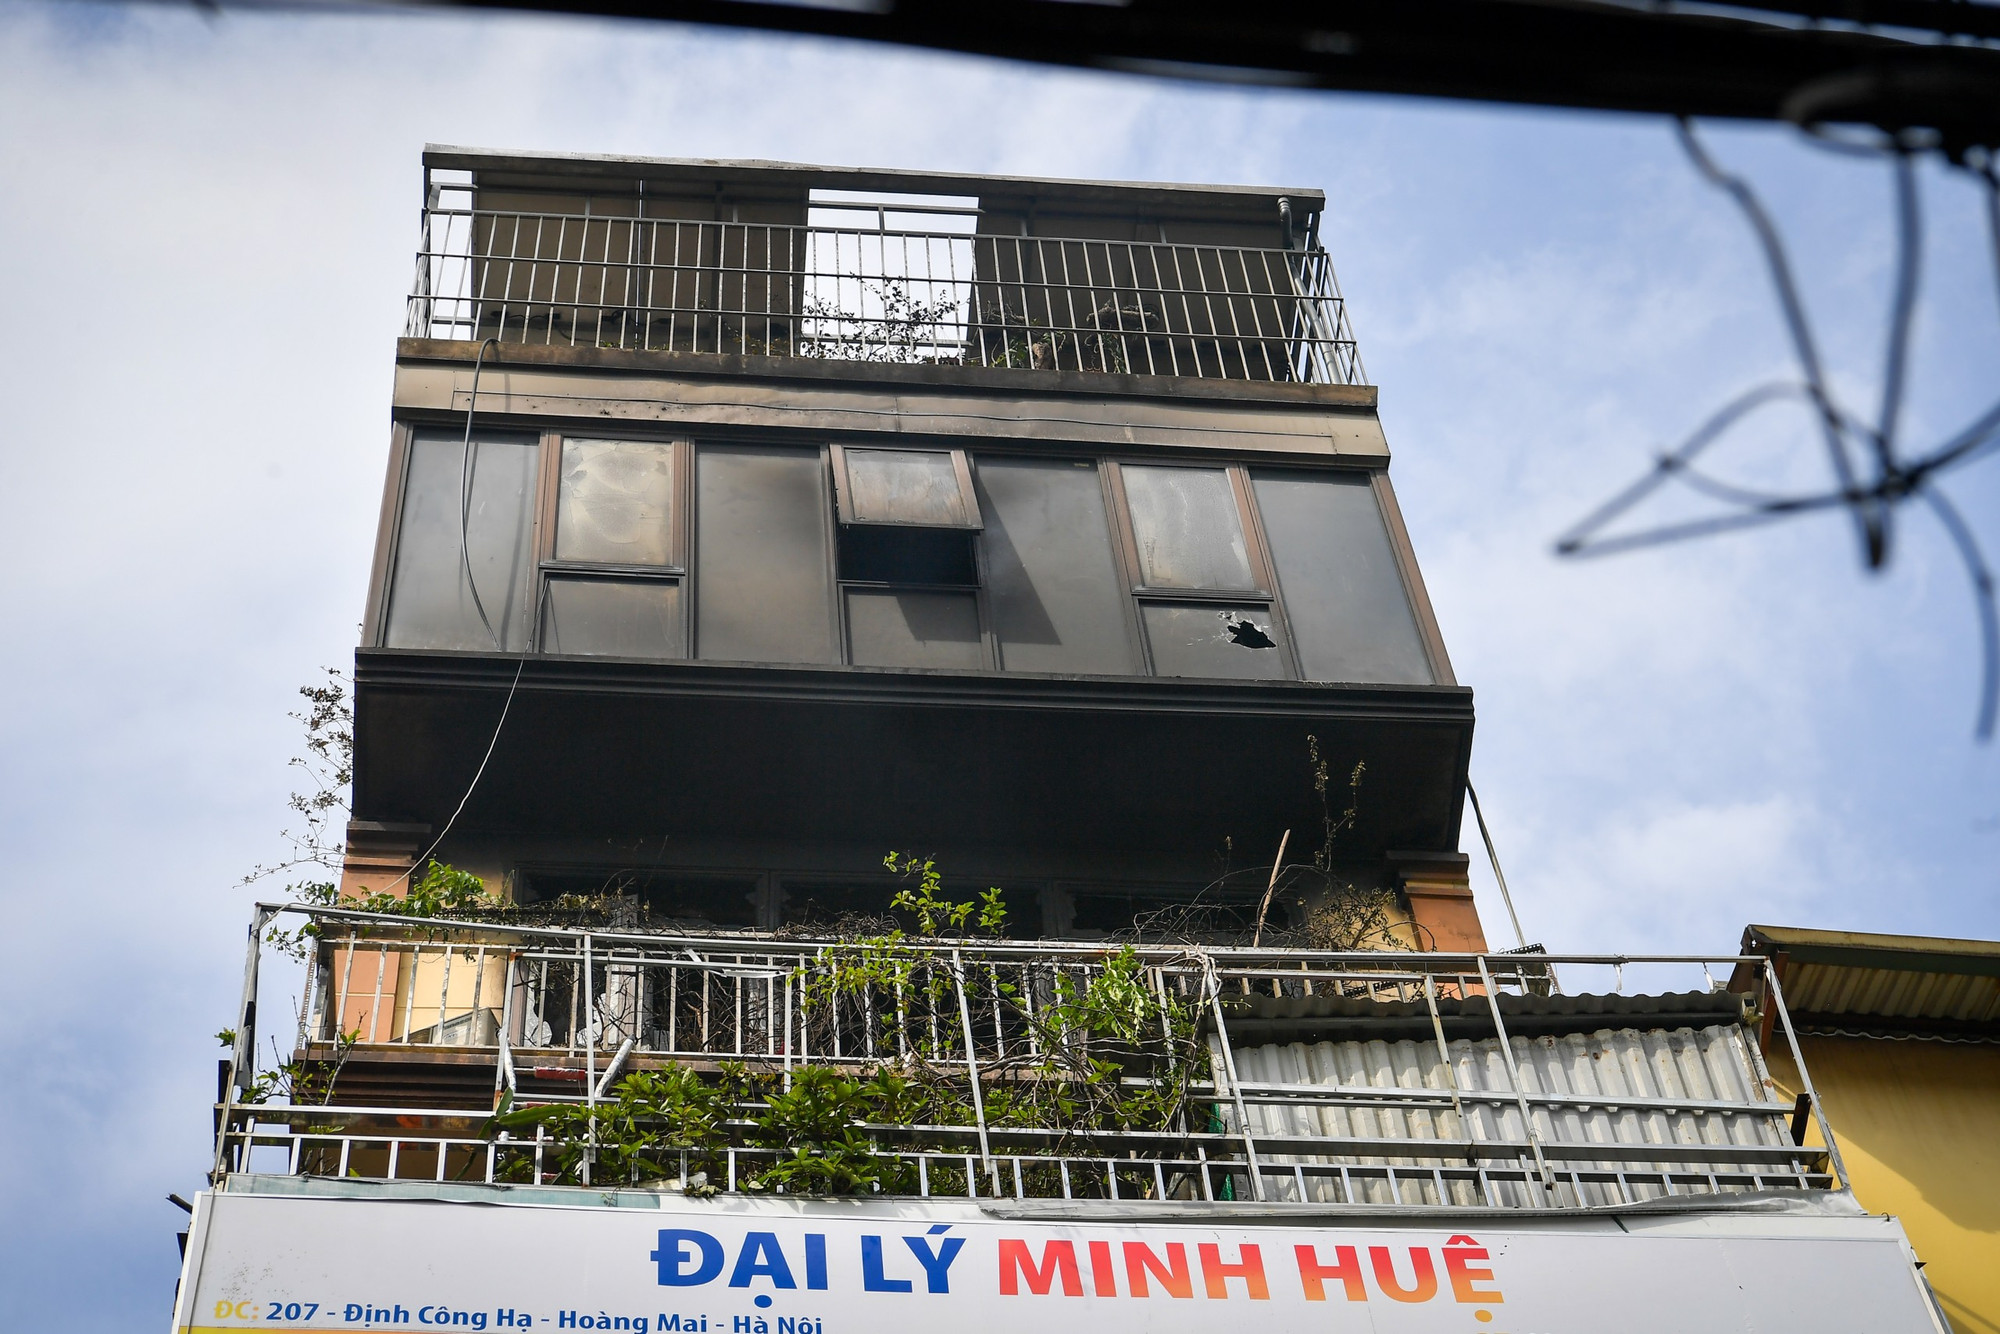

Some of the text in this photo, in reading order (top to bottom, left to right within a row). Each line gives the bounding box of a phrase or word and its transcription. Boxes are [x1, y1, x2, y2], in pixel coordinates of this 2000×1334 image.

[651, 1225, 1505, 1323] ĐẠI LÝ MINH HUỆ
[213, 1300, 260, 1320] ĐC:
[265, 1302, 320, 1321] 207
[343, 1302, 411, 1328] Định
[418, 1304, 488, 1331] Công
[496, 1308, 532, 1332] Hạ
[558, 1309, 649, 1334] Hoàng
[656, 1312, 708, 1333] Mai
[733, 1314, 770, 1334] Hà
